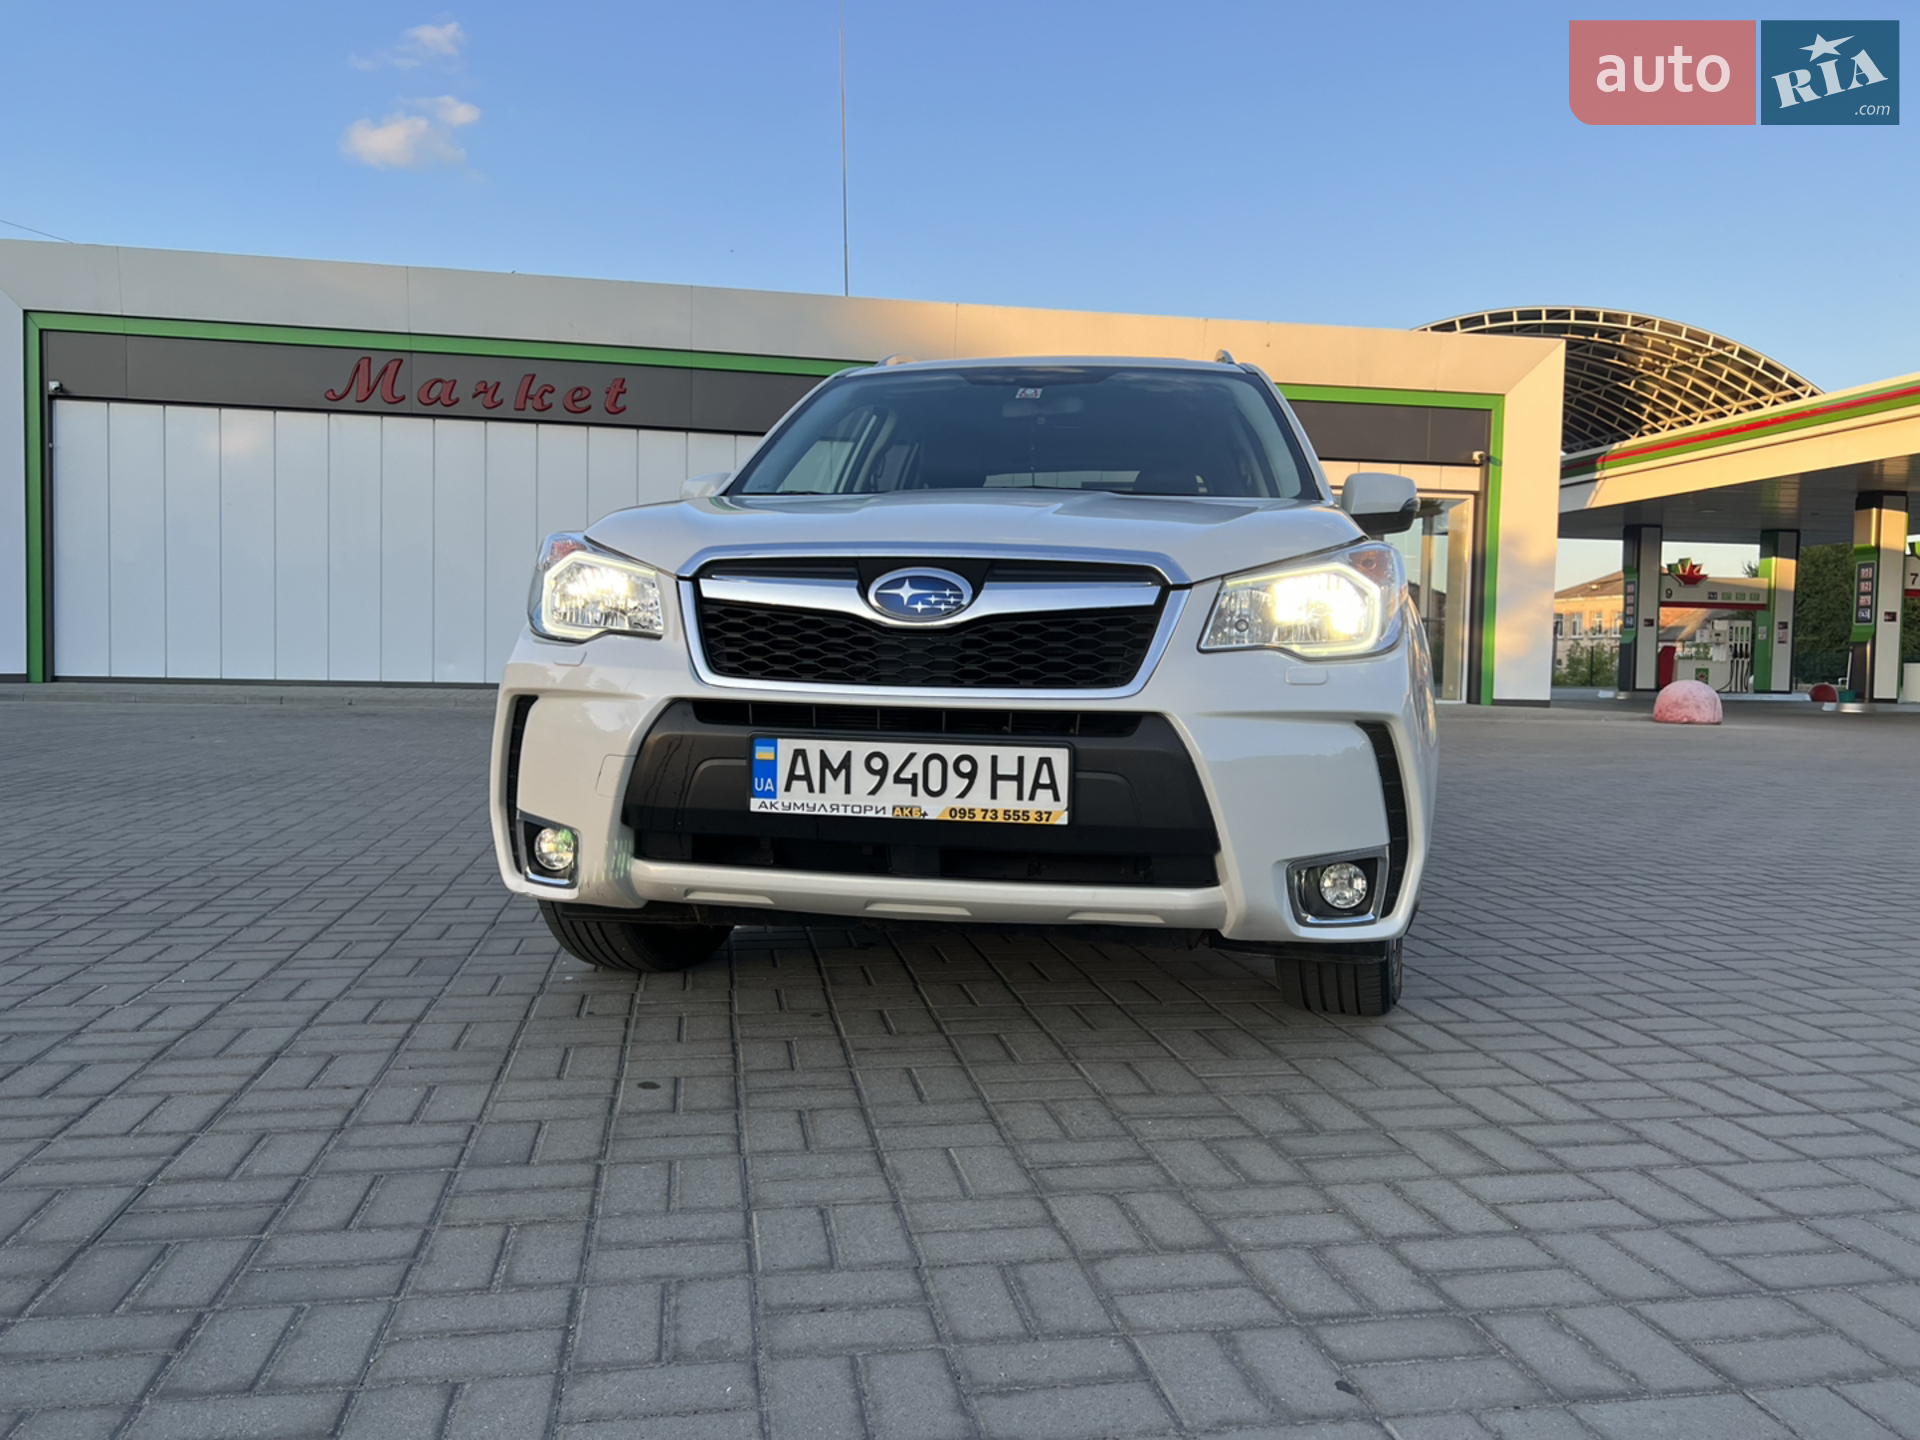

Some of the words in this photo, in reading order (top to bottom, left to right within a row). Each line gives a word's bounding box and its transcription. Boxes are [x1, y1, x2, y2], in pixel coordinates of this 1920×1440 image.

[324, 356, 628, 415] Market
[1910, 572, 1919, 585] 7
[1665, 588, 1673, 599] 9
[864, 751, 978, 799] 9409
[754, 777, 775, 792] UA
[758, 800, 886, 815] АКУМУЛЯТОРИ
[949, 808, 976, 819] 095
[981, 809, 998, 820] 73
[1003, 810, 1030, 822] 555
[1034, 811, 1052, 822] 37
